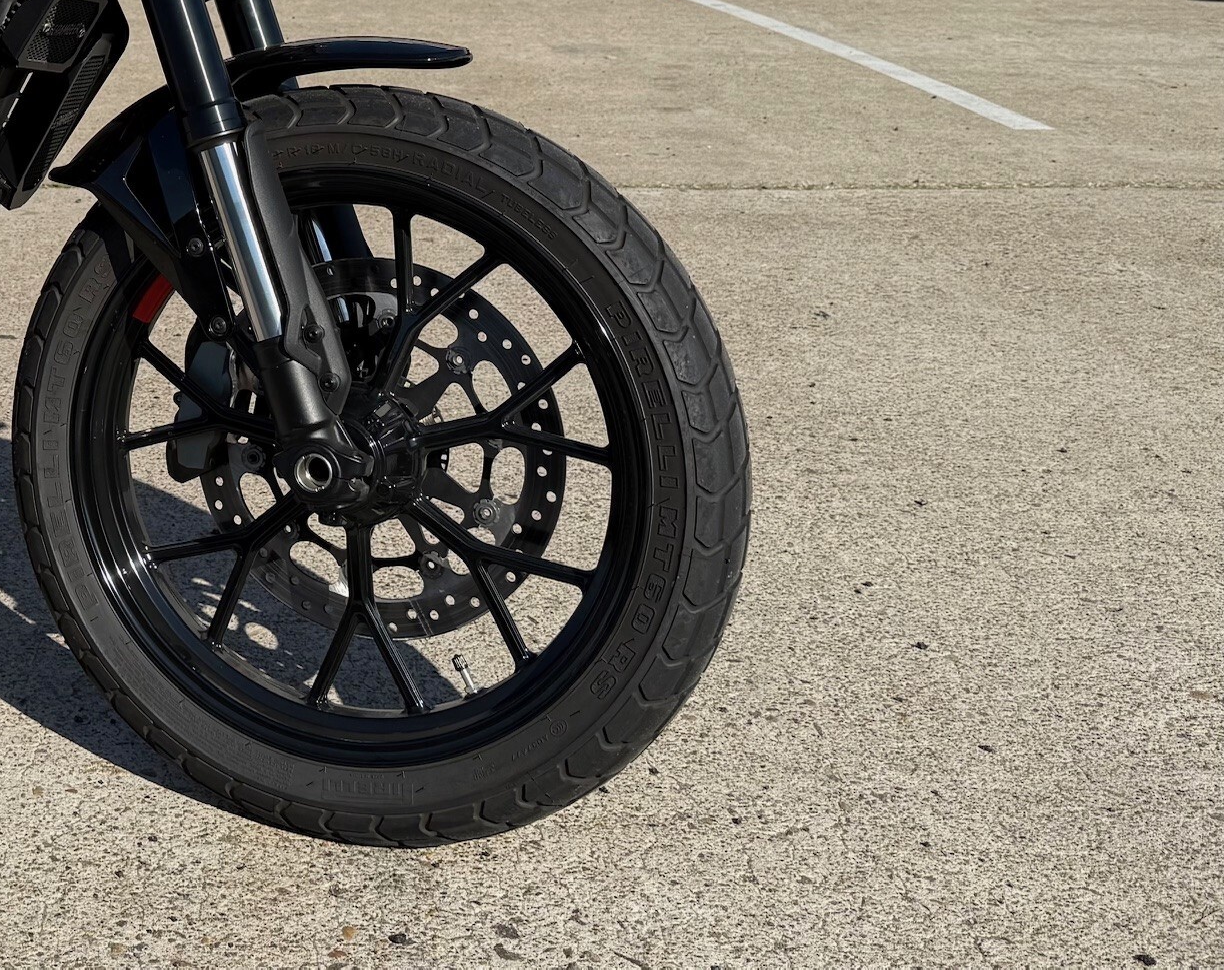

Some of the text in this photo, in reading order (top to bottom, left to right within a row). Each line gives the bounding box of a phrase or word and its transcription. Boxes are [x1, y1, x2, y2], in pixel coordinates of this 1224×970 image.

[412, 150, 488, 194] RADIAL
[500, 192, 559, 240] TUBELESS
[42, 436, 100, 614] PIRELLI
[588, 302, 680, 702] PIRELLI MT60 RS
